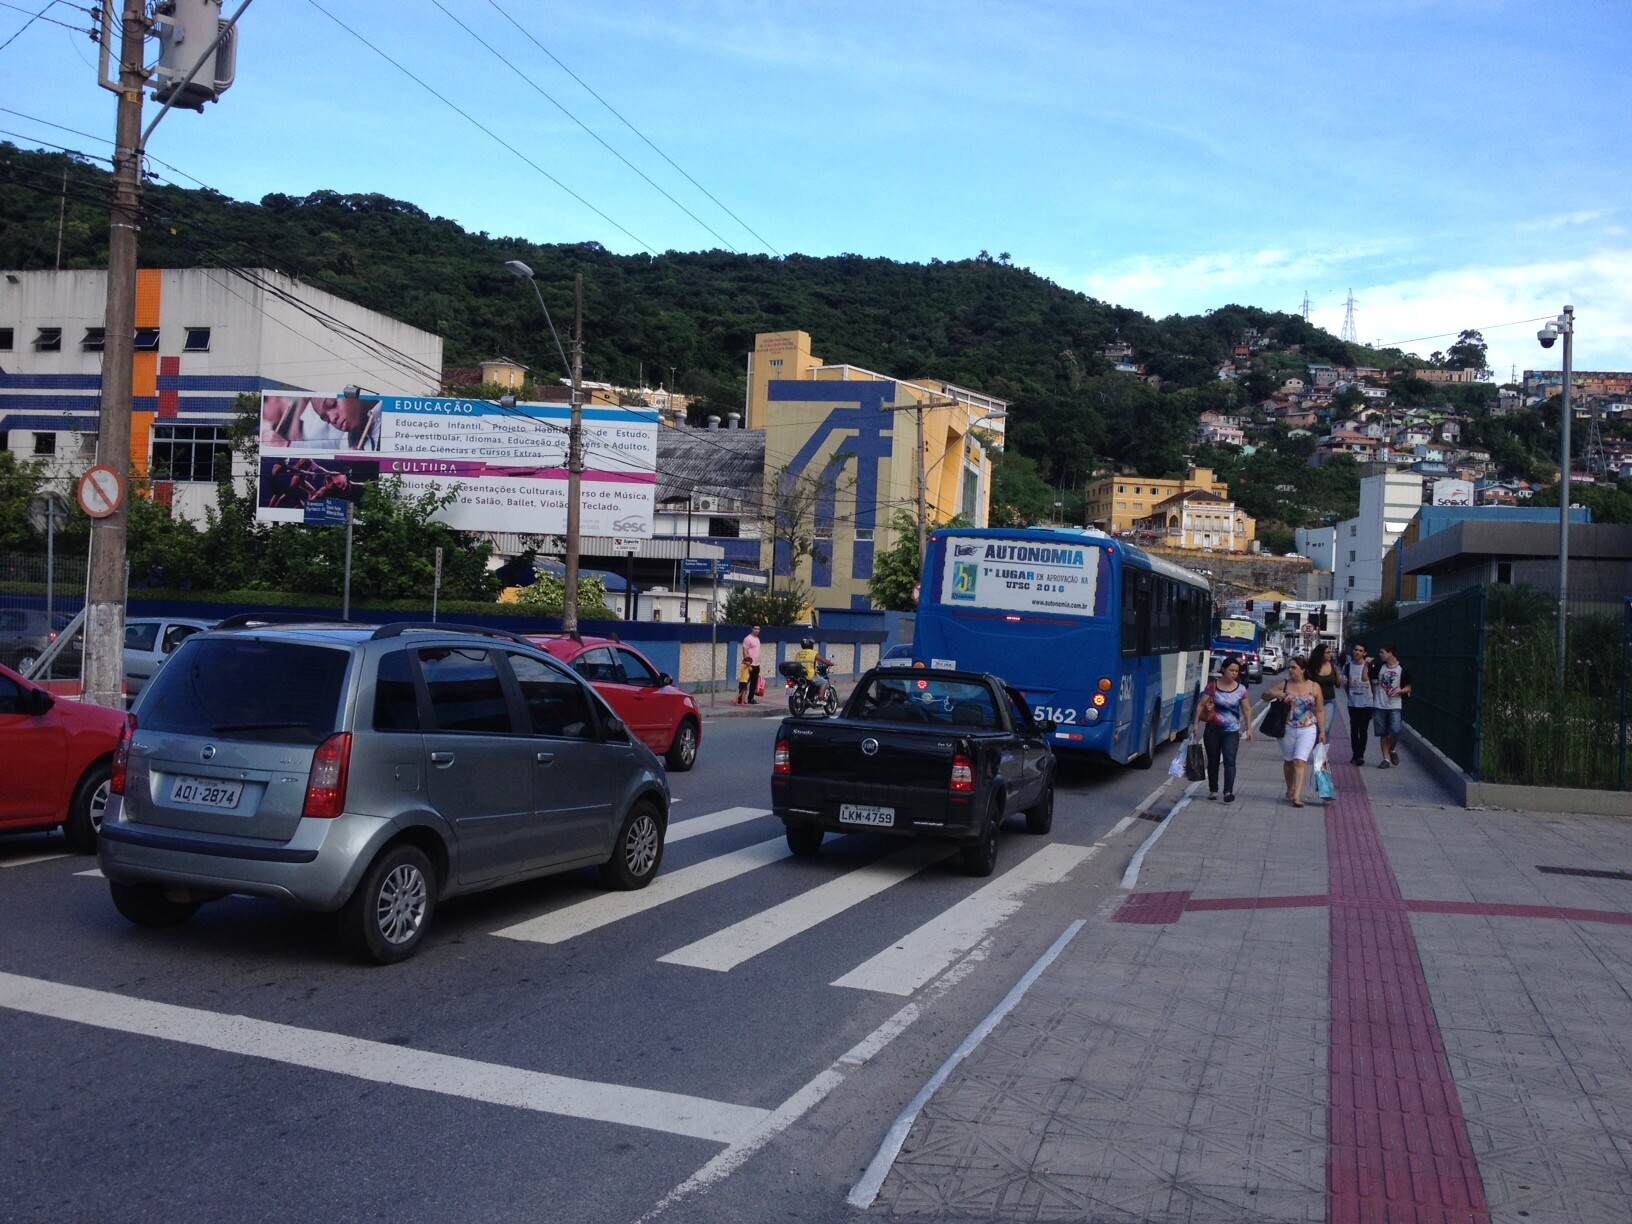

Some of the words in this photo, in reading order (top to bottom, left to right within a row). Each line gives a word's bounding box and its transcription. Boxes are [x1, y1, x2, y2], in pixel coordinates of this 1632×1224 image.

[395, 399, 473, 414] EDUCAÇÃO
[395, 419, 440, 429] Educação
[448, 422, 484, 431] Infantil,
[493, 424, 526, 433] Projeto
[597, 428, 608, 436] de
[616, 430, 650, 439] Estudo,
[395, 431, 463, 442] Pré-vestibular,
[466, 435, 505, 444] Idiomas,
[508, 437, 551, 447] Educação
[554, 439, 566, 447] de
[612, 443, 649, 451] Adultos,
[394, 444, 413, 452] Sala
[430, 445, 468, 454] Ciências
[480, 448, 511, 456] Cursos
[514, 450, 545, 458] Extras.
[392, 462, 457, 474] CULTURA
[520, 487, 565, 497] Culturais,
[600, 490, 611, 498] de
[614, 491, 649, 501] Música,
[475, 497, 503, 506] Salão,
[507, 498, 537, 508] Ballet,
[582, 502, 621, 511] Teclado.
[985, 544, 1084, 566] AUTONOMIA
[995, 569, 1035, 581] LUGAR
[1036, 573, 1044, 581] EM
[1046, 573, 1078, 585] APROVAÇÃO
[1081, 577, 1089, 585] NA
[1006, 581, 1031, 590] UFSC
[1036, 584, 1065, 593] 2016
[1032, 599, 1088, 610] www.autonomia.com.br
[1033, 705, 1076, 725] 5162
